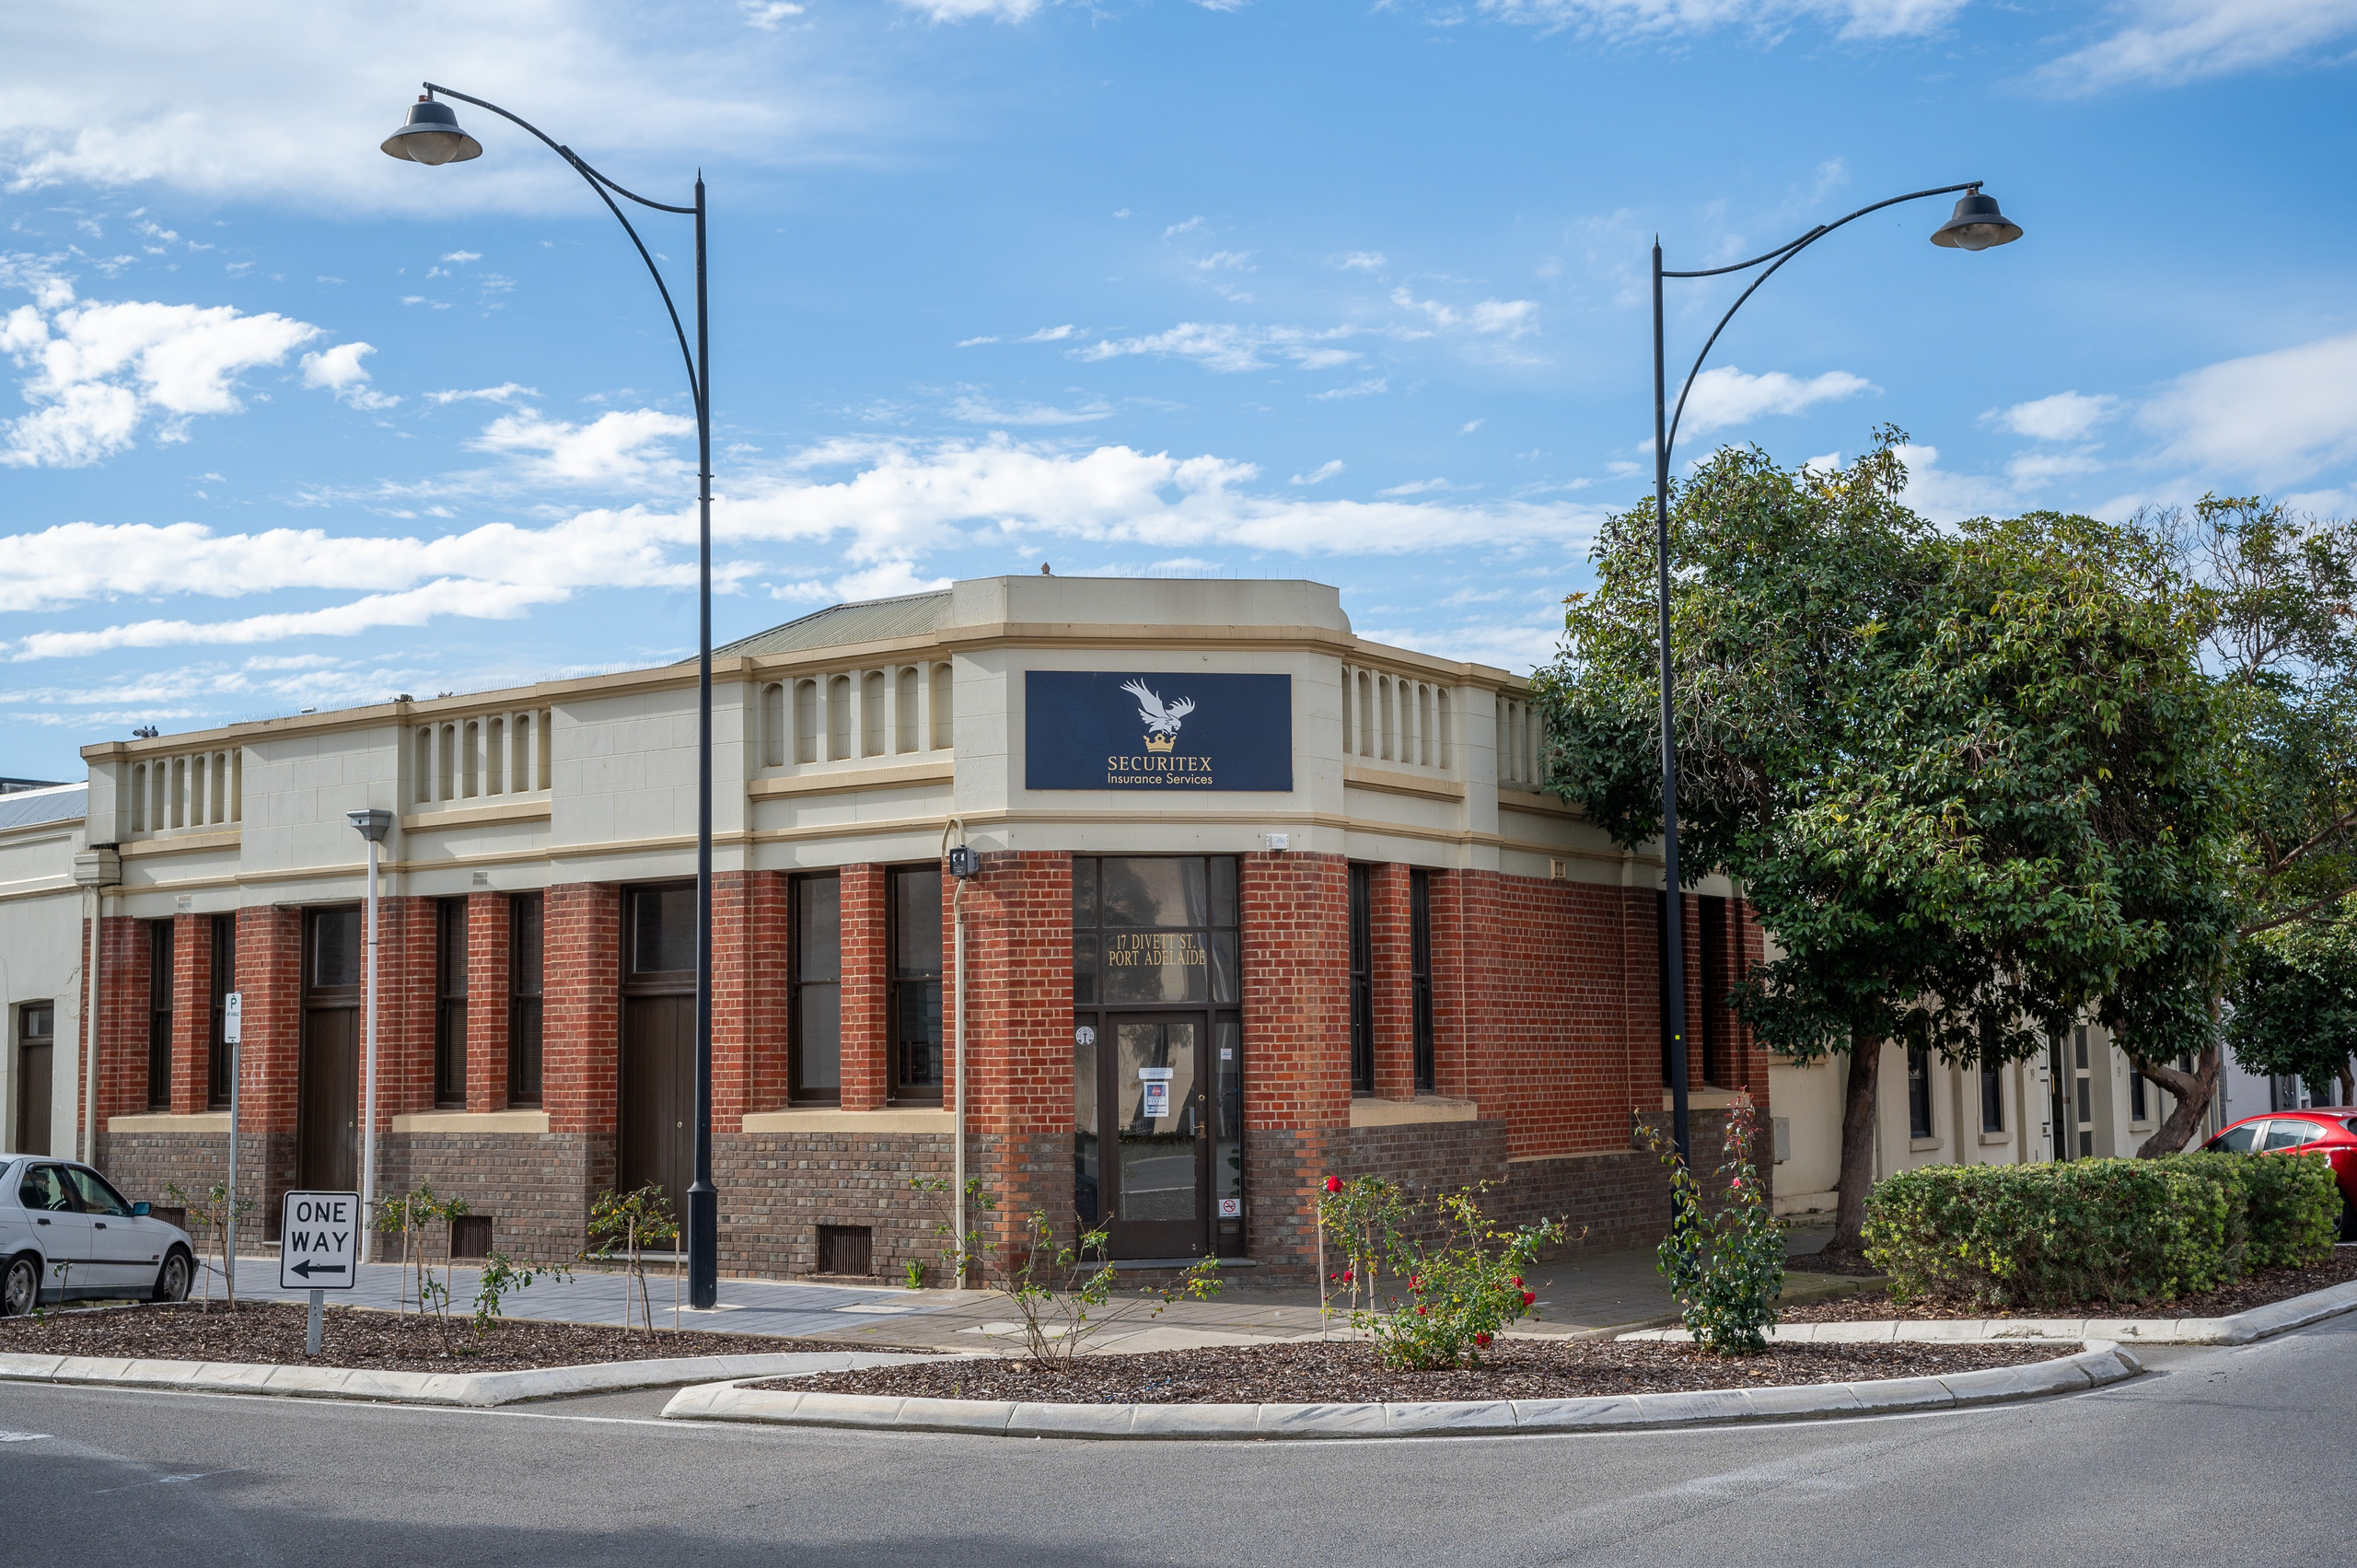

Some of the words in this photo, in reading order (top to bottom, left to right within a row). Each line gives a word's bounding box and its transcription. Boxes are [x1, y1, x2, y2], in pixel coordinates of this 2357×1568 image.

[1108, 756, 1213, 772] SECURITEX
[1108, 772, 1162, 784] Insurance
[1166, 772, 1213, 784] Services
[1117, 934, 1127, 949] 17
[1132, 934, 1176, 949] DIVETT
[1179, 933, 1196, 949] ST.
[1109, 950, 1140, 967] PORT
[1144, 949, 1206, 966] ADELAIDE
[230, 997, 238, 1009] P
[296, 1201, 347, 1224] ONE
[291, 1231, 350, 1253] WAY
